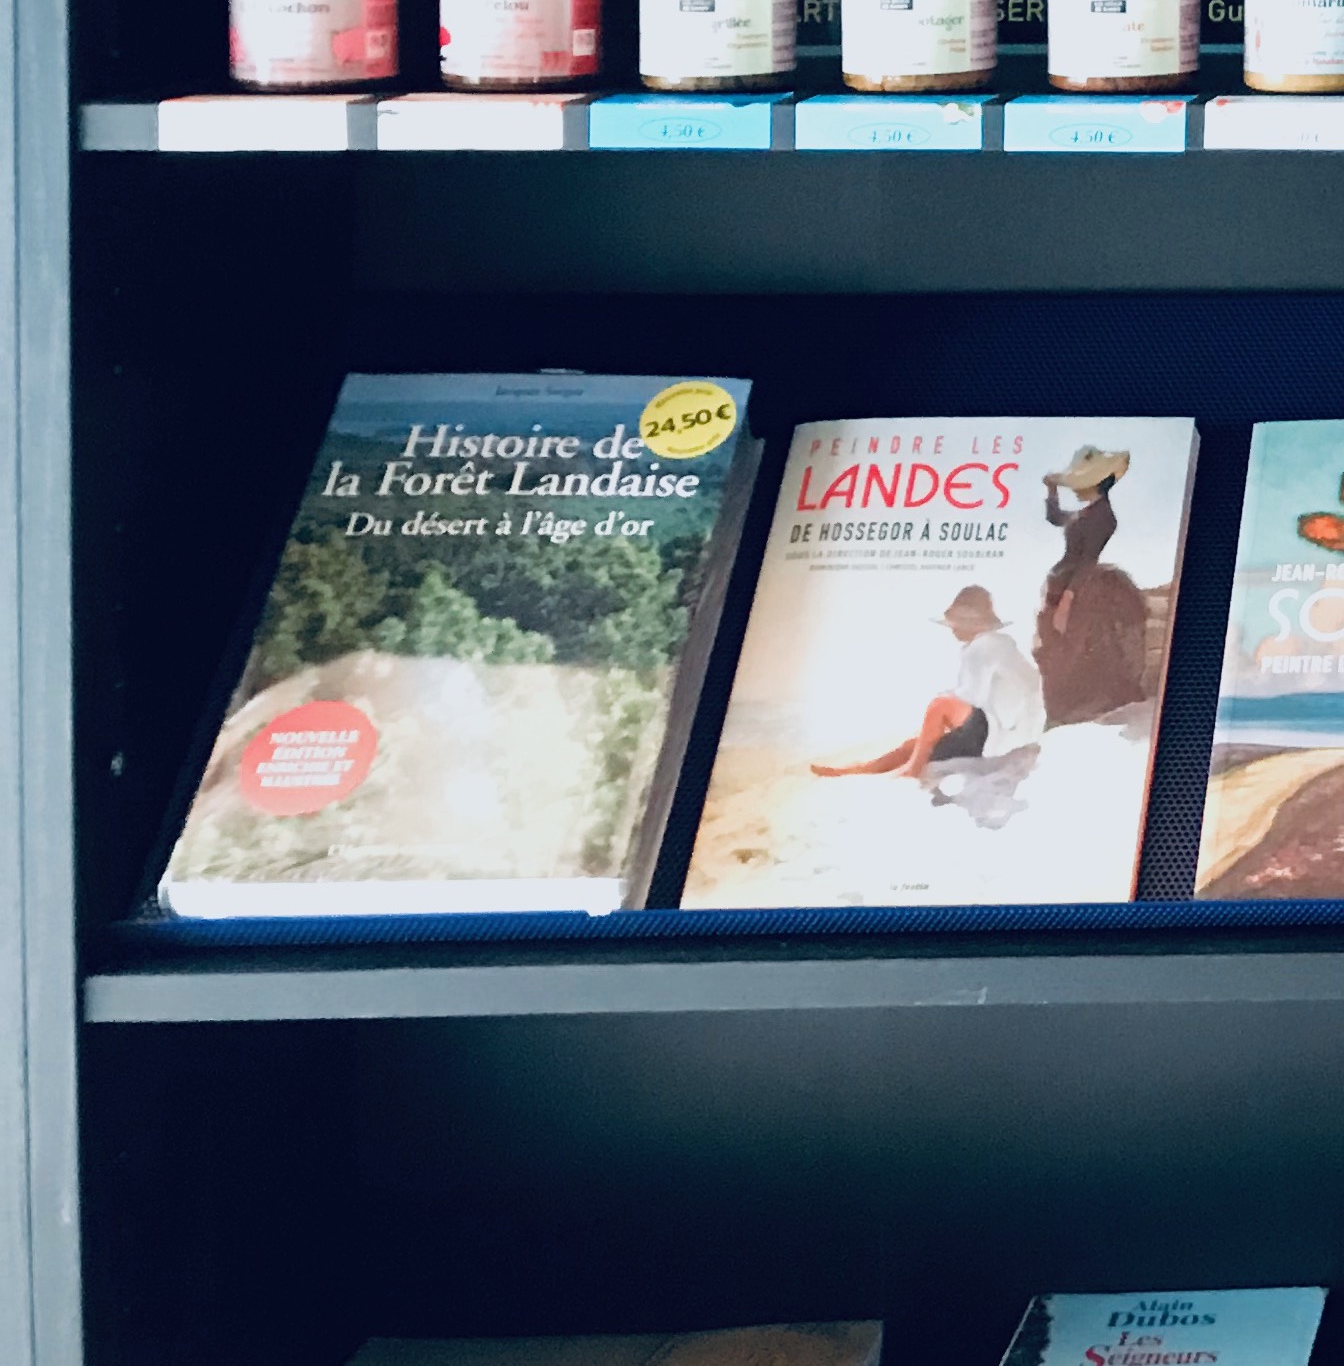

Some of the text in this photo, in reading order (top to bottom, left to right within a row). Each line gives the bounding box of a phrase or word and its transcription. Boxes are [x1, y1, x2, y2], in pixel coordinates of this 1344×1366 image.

[645, 402, 732, 439] 24,50 €
[401, 424, 581, 460] Histoire
[592, 423, 645, 460] de
[810, 435, 1024, 457] PEINDRE LES
[321, 459, 700, 498] la Forêt Landaise
[796, 462, 1020, 512] LANDES
[344, 510, 655, 544] Du désert à l'âge d'or
[789, 517, 1010, 544] DE HOSSEGOR À SOULAC
[1260, 654, 1334, 675] PEINTRE
[1132, 1298, 1194, 1312] Alain
[1107, 1310, 1217, 1328] Dubos
[1118, 1331, 1166, 1347] Les
